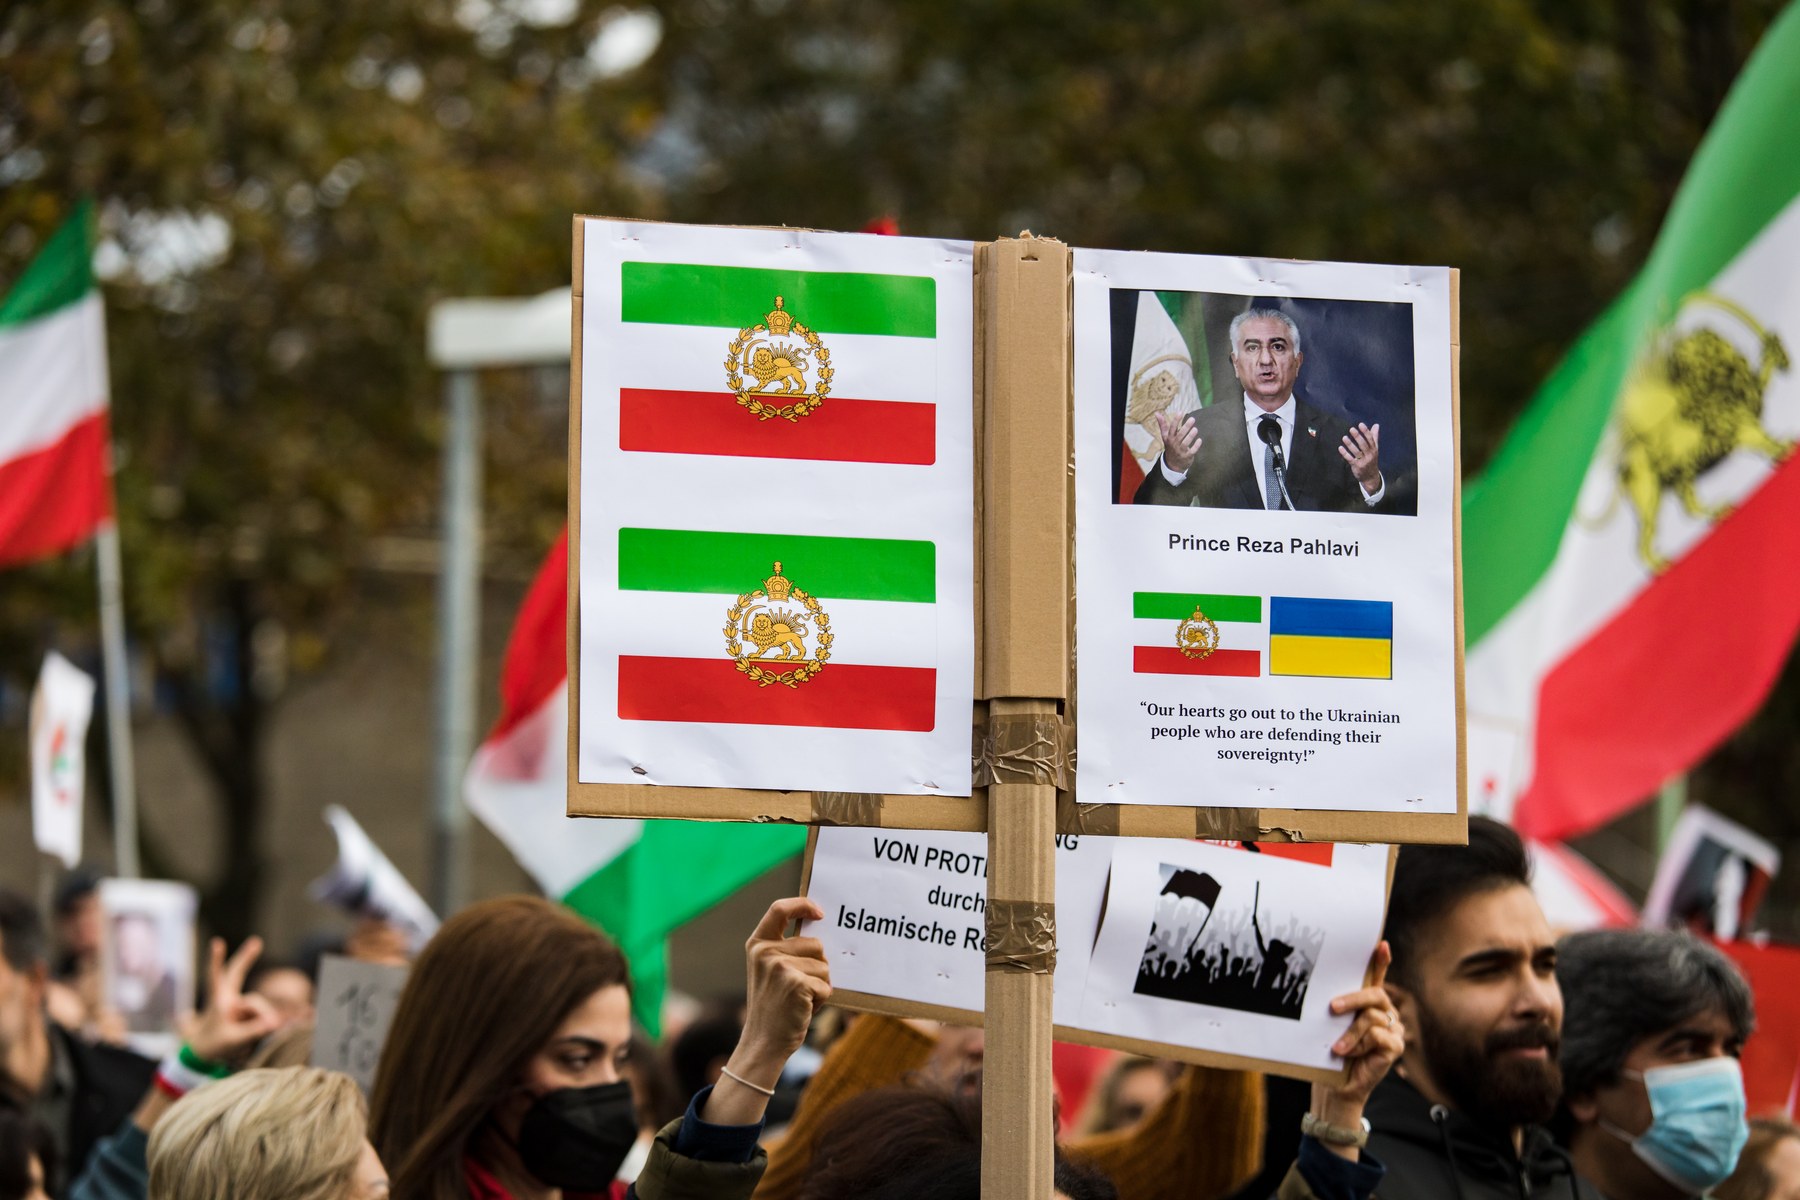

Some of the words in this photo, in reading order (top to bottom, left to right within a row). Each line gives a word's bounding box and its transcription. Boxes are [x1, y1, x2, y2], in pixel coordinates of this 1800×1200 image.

[1169, 533, 1230, 551] Prince
[1237, 536, 1284, 553] Reza
[1290, 538, 1359, 557] Pahlavi
[1140, 701, 1175, 717] “Our
[1179, 704, 1225, 718] hearts
[1229, 708, 1247, 721] go
[1251, 708, 1276, 720] out
[1280, 708, 1295, 720] to
[1299, 708, 1323, 721] the
[1327, 709, 1400, 724] Ukrainian
[1151, 725, 1200, 740] people
[1204, 725, 1236, 739] who
[1240, 729, 1263, 740] are
[1267, 727, 1341, 745] defending
[1345, 730, 1381, 743] their
[1217, 748, 1315, 764] sovereignty!”
[873, 837, 919, 866] VON
[924, 847, 988, 878] PROT
[928, 885, 985, 913] durch
[837, 905, 957, 947] Islamische
